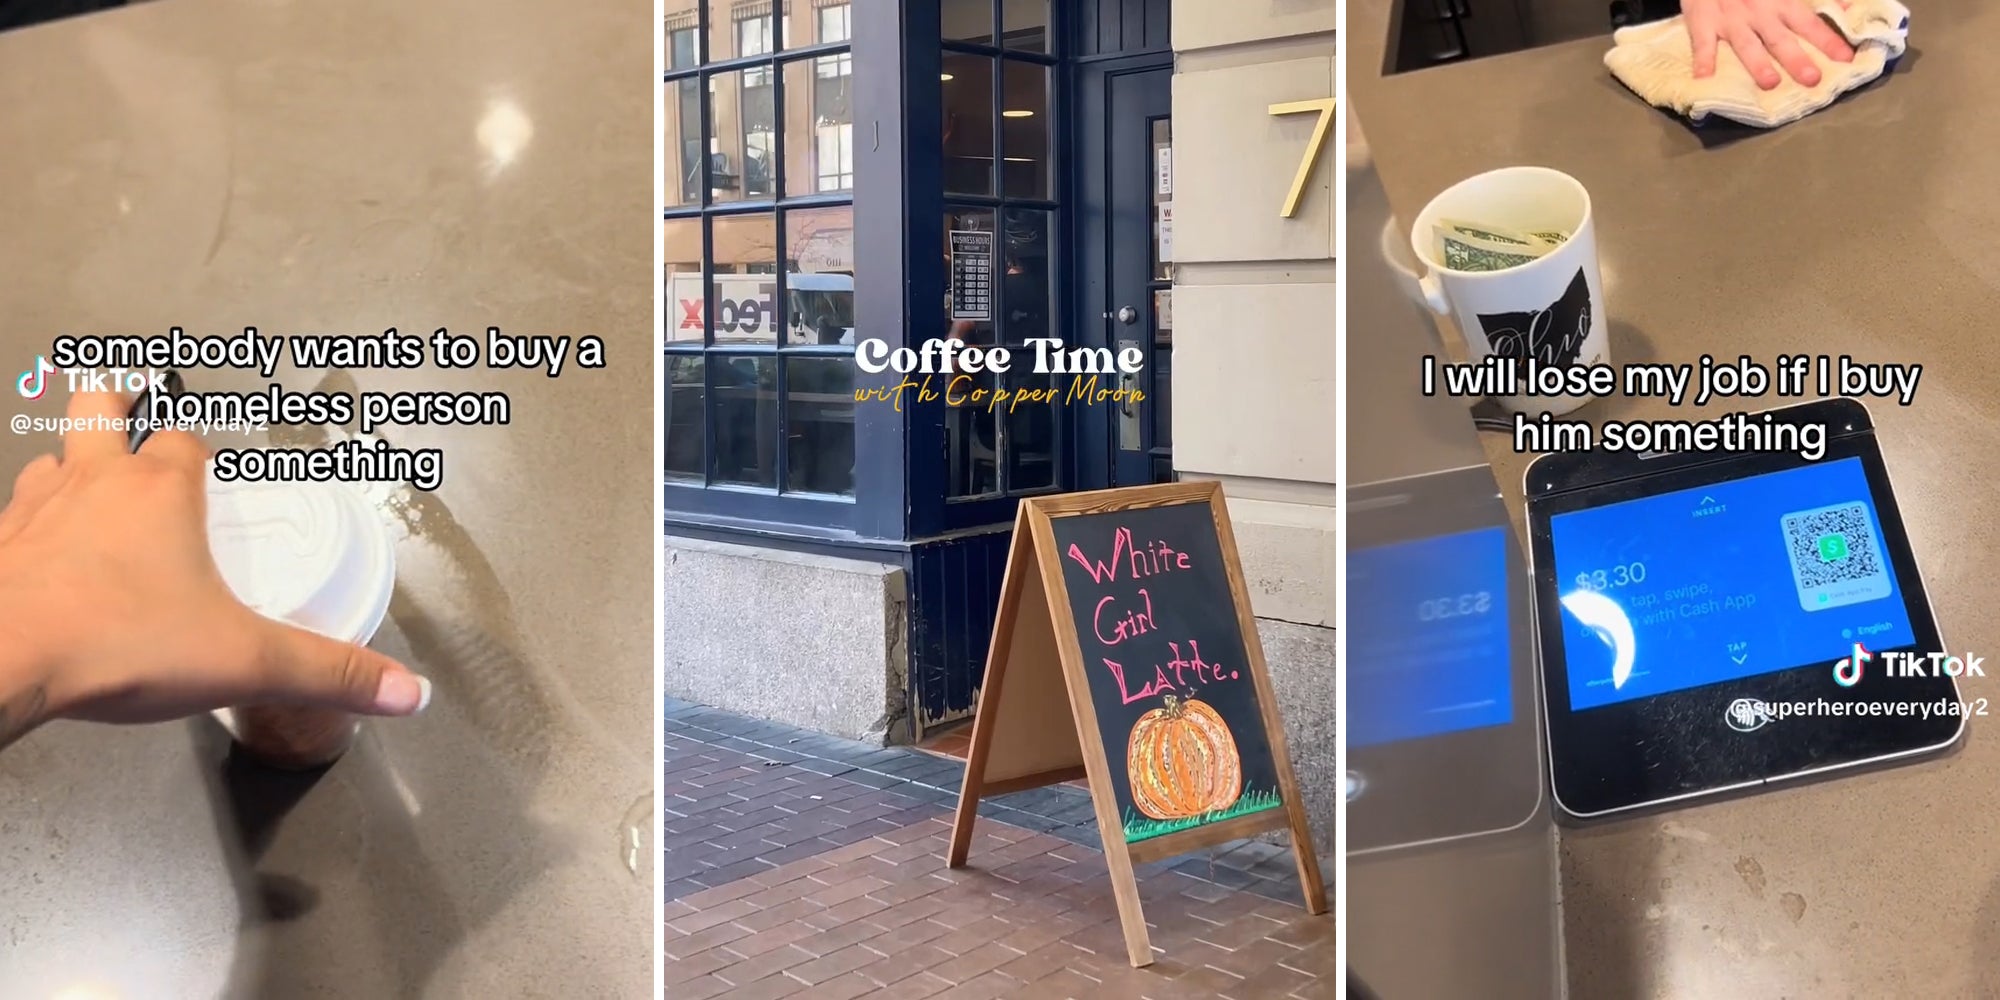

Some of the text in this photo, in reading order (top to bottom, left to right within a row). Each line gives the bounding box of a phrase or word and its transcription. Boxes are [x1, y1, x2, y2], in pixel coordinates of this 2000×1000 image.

[1268, 97, 1336, 218] 7
[1692, 504, 1727, 518] INSERT
[1068, 526, 1192, 584] White
[1575, 562, 1647, 591] $3.30
[1631, 582, 1713, 609] tap, swipe,
[1643, 607, 1676, 626] with
[1679, 600, 1720, 618] Cash
[1724, 593, 1757, 612] App
[1094, 588, 1158, 646] Girl
[1857, 621, 1893, 636] English
[1727, 641, 1748, 653] TAP
